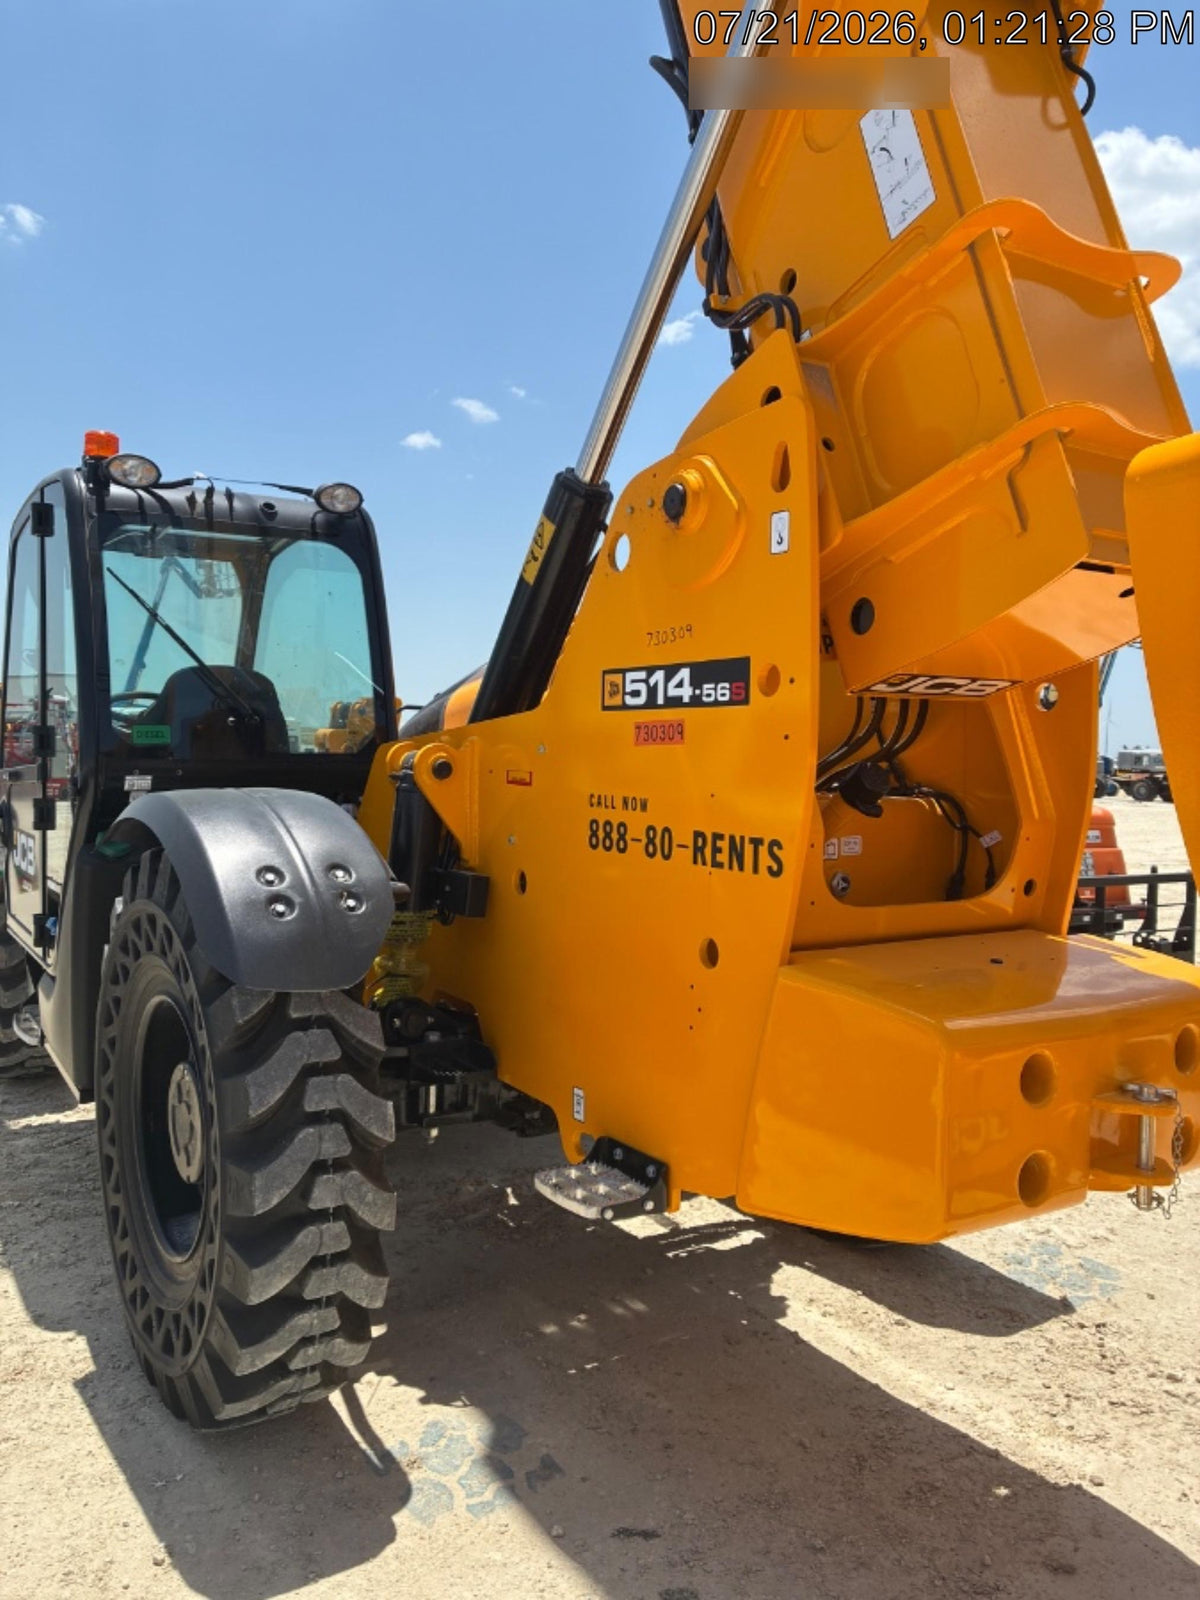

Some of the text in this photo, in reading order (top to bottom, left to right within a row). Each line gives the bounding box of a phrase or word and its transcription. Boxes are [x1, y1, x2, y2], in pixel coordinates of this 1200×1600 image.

[646, 624, 693, 647] 730309
[869, 676, 1013, 696] JCB
[634, 723, 684, 742] 730309
[588, 793, 649, 813] CALL NOW
[13, 830, 35, 876] JCB
[588, 818, 784, 878] 888-80-RENTS
